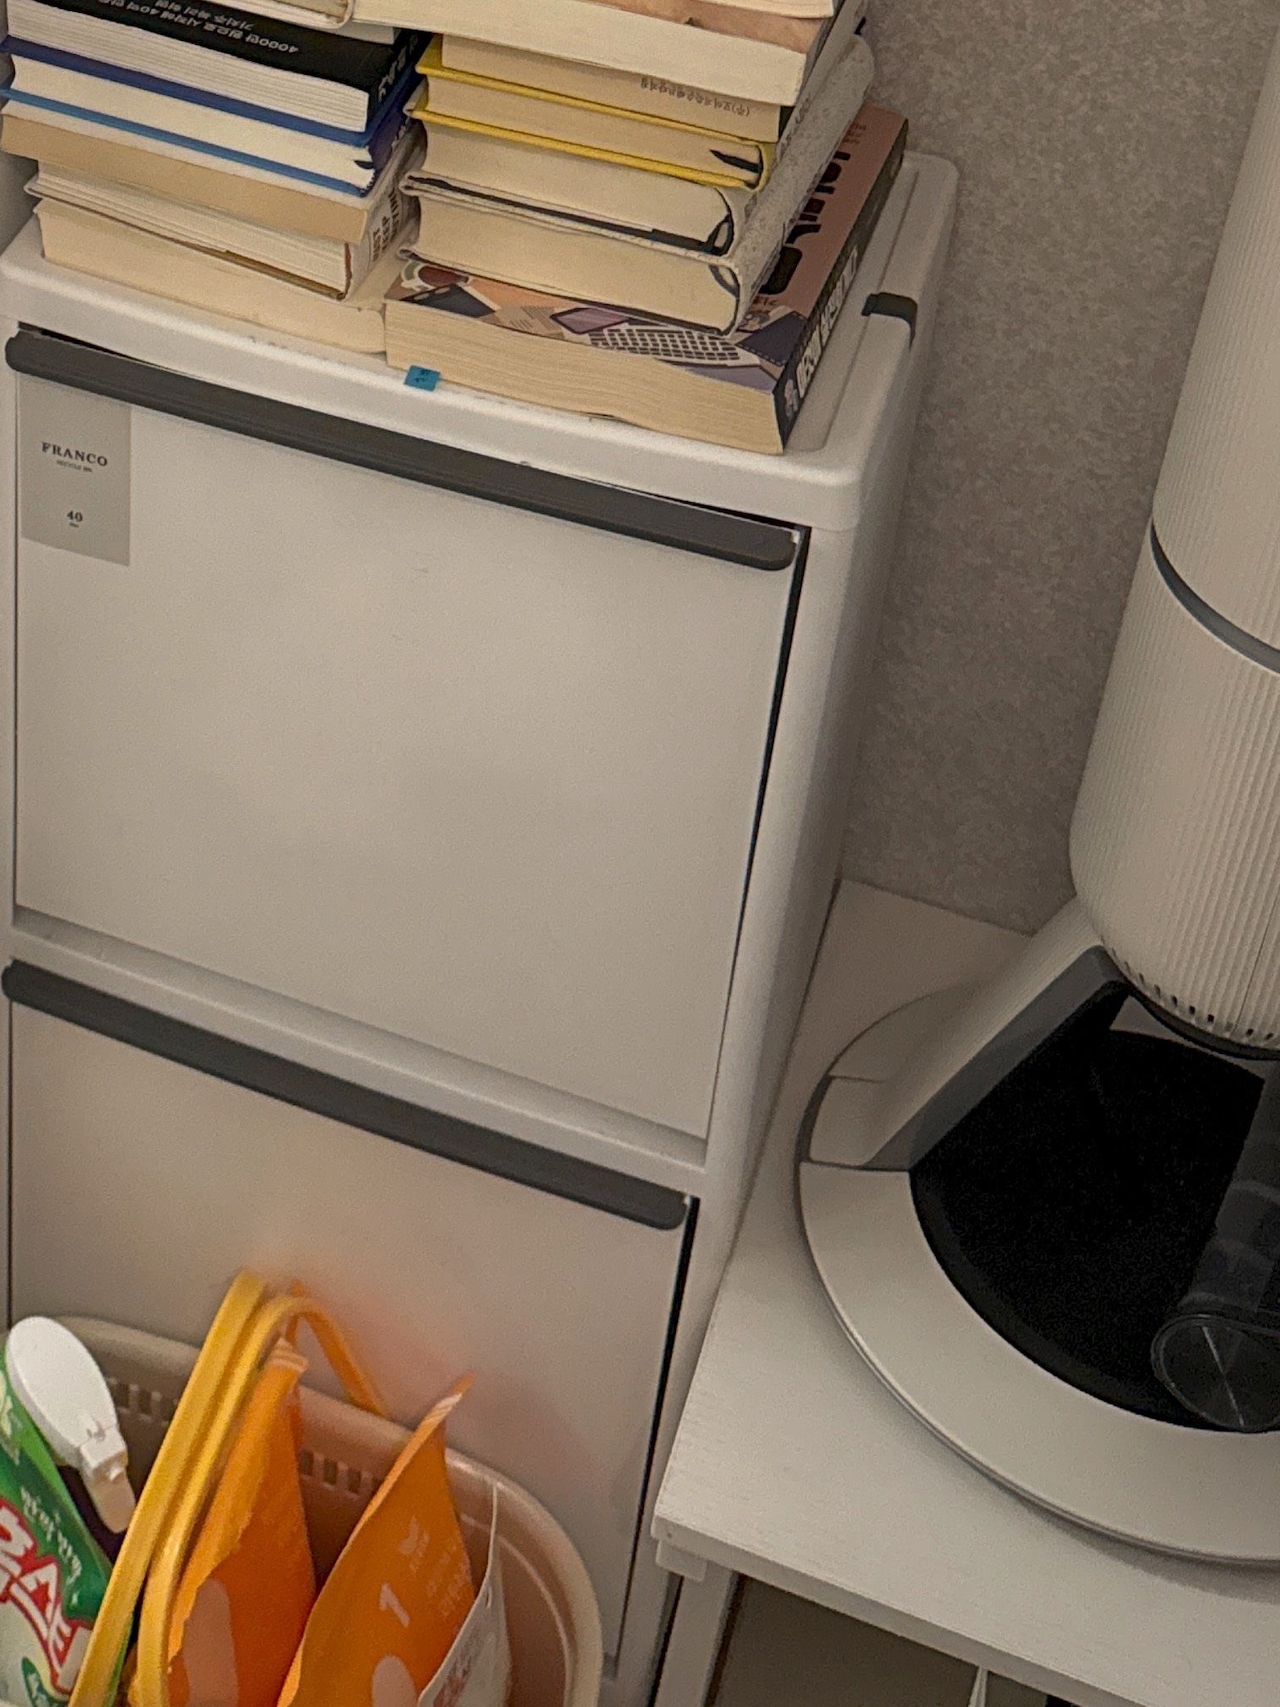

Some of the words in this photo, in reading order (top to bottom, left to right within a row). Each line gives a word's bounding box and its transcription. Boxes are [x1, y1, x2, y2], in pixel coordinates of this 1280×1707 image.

[126, 1, 160, 16] 40억
[245, 33, 299, 53] 4000만
[41, 441, 108, 467] FRANCO
[66, 510, 83, 522] 40
